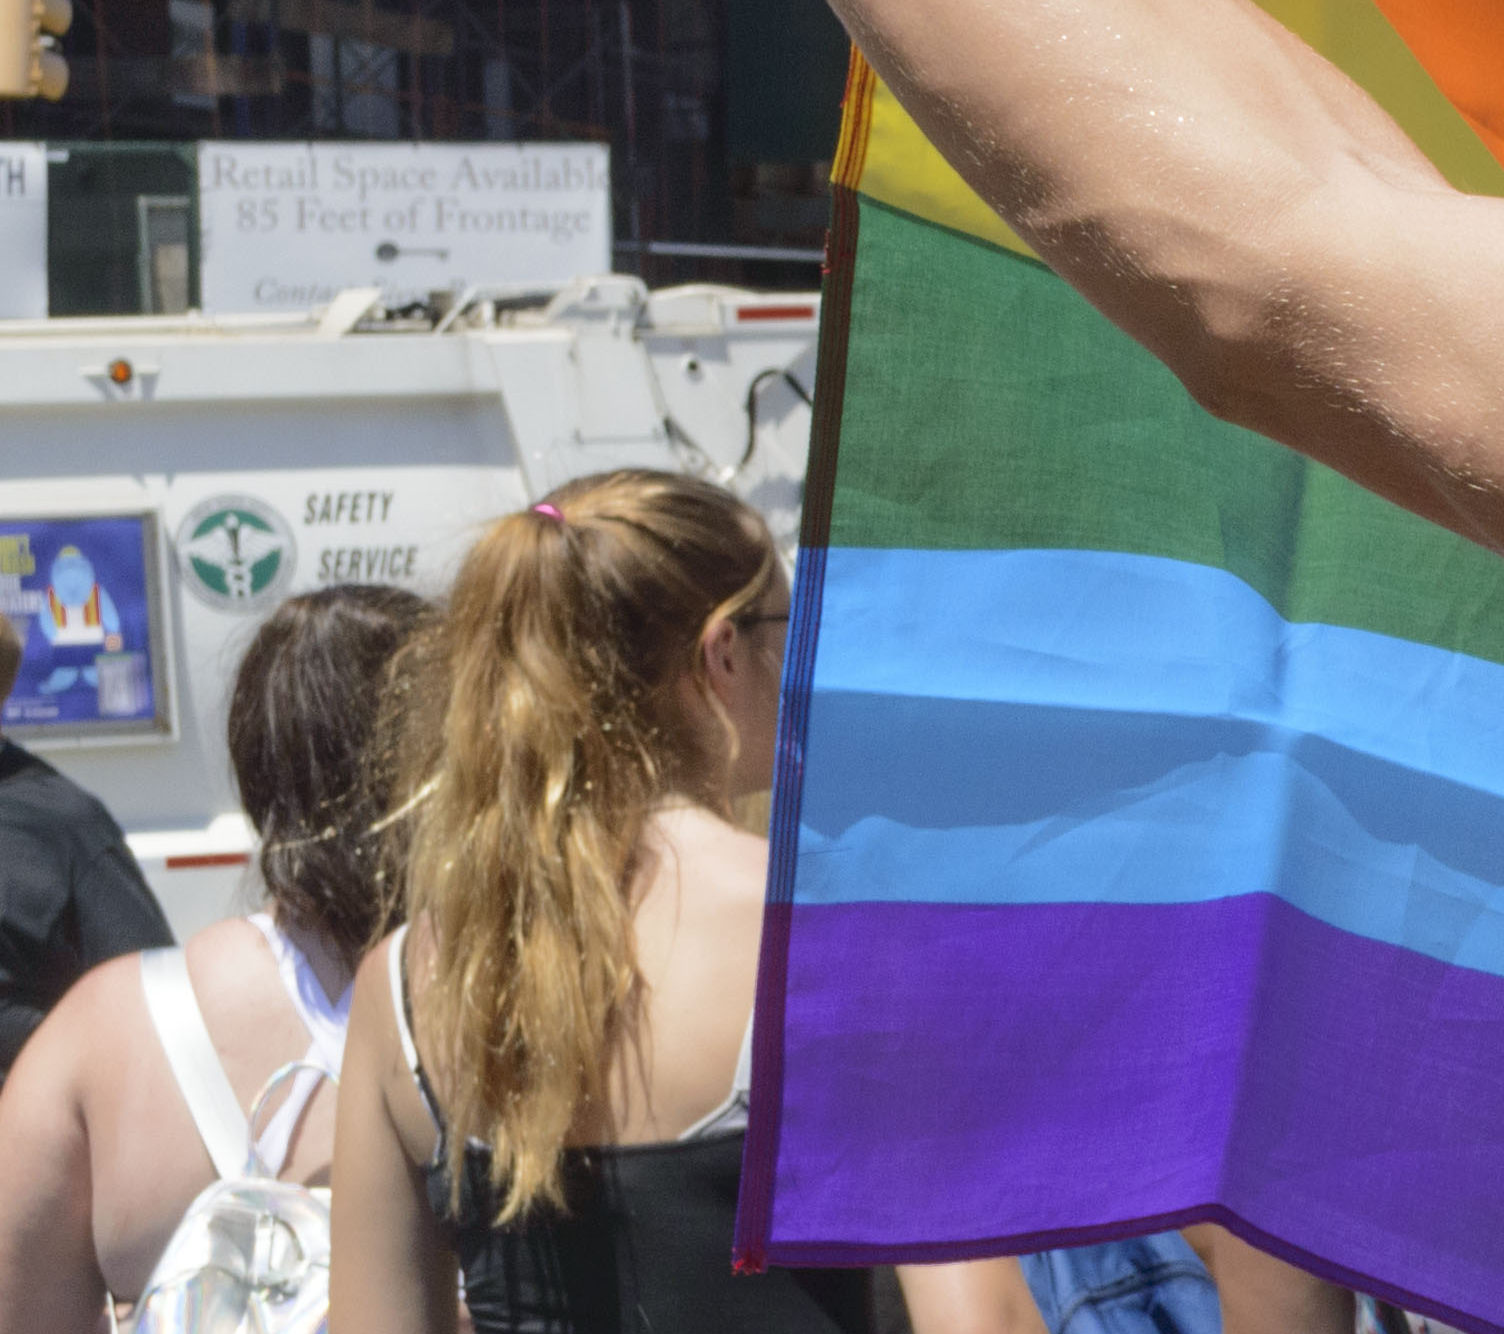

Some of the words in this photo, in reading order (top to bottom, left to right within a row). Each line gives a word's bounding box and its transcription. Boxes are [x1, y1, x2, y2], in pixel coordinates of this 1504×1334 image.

[212, 154, 319, 192] Retail
[333, 154, 437, 200] Space
[235, 197, 280, 234] 85
[295, 197, 372, 234] Feet
[383, 195, 428, 234] of
[434, 197, 593, 244] Frontage
[303, 491, 395, 525] SAFETY
[318, 545, 419, 581] SERVICE
